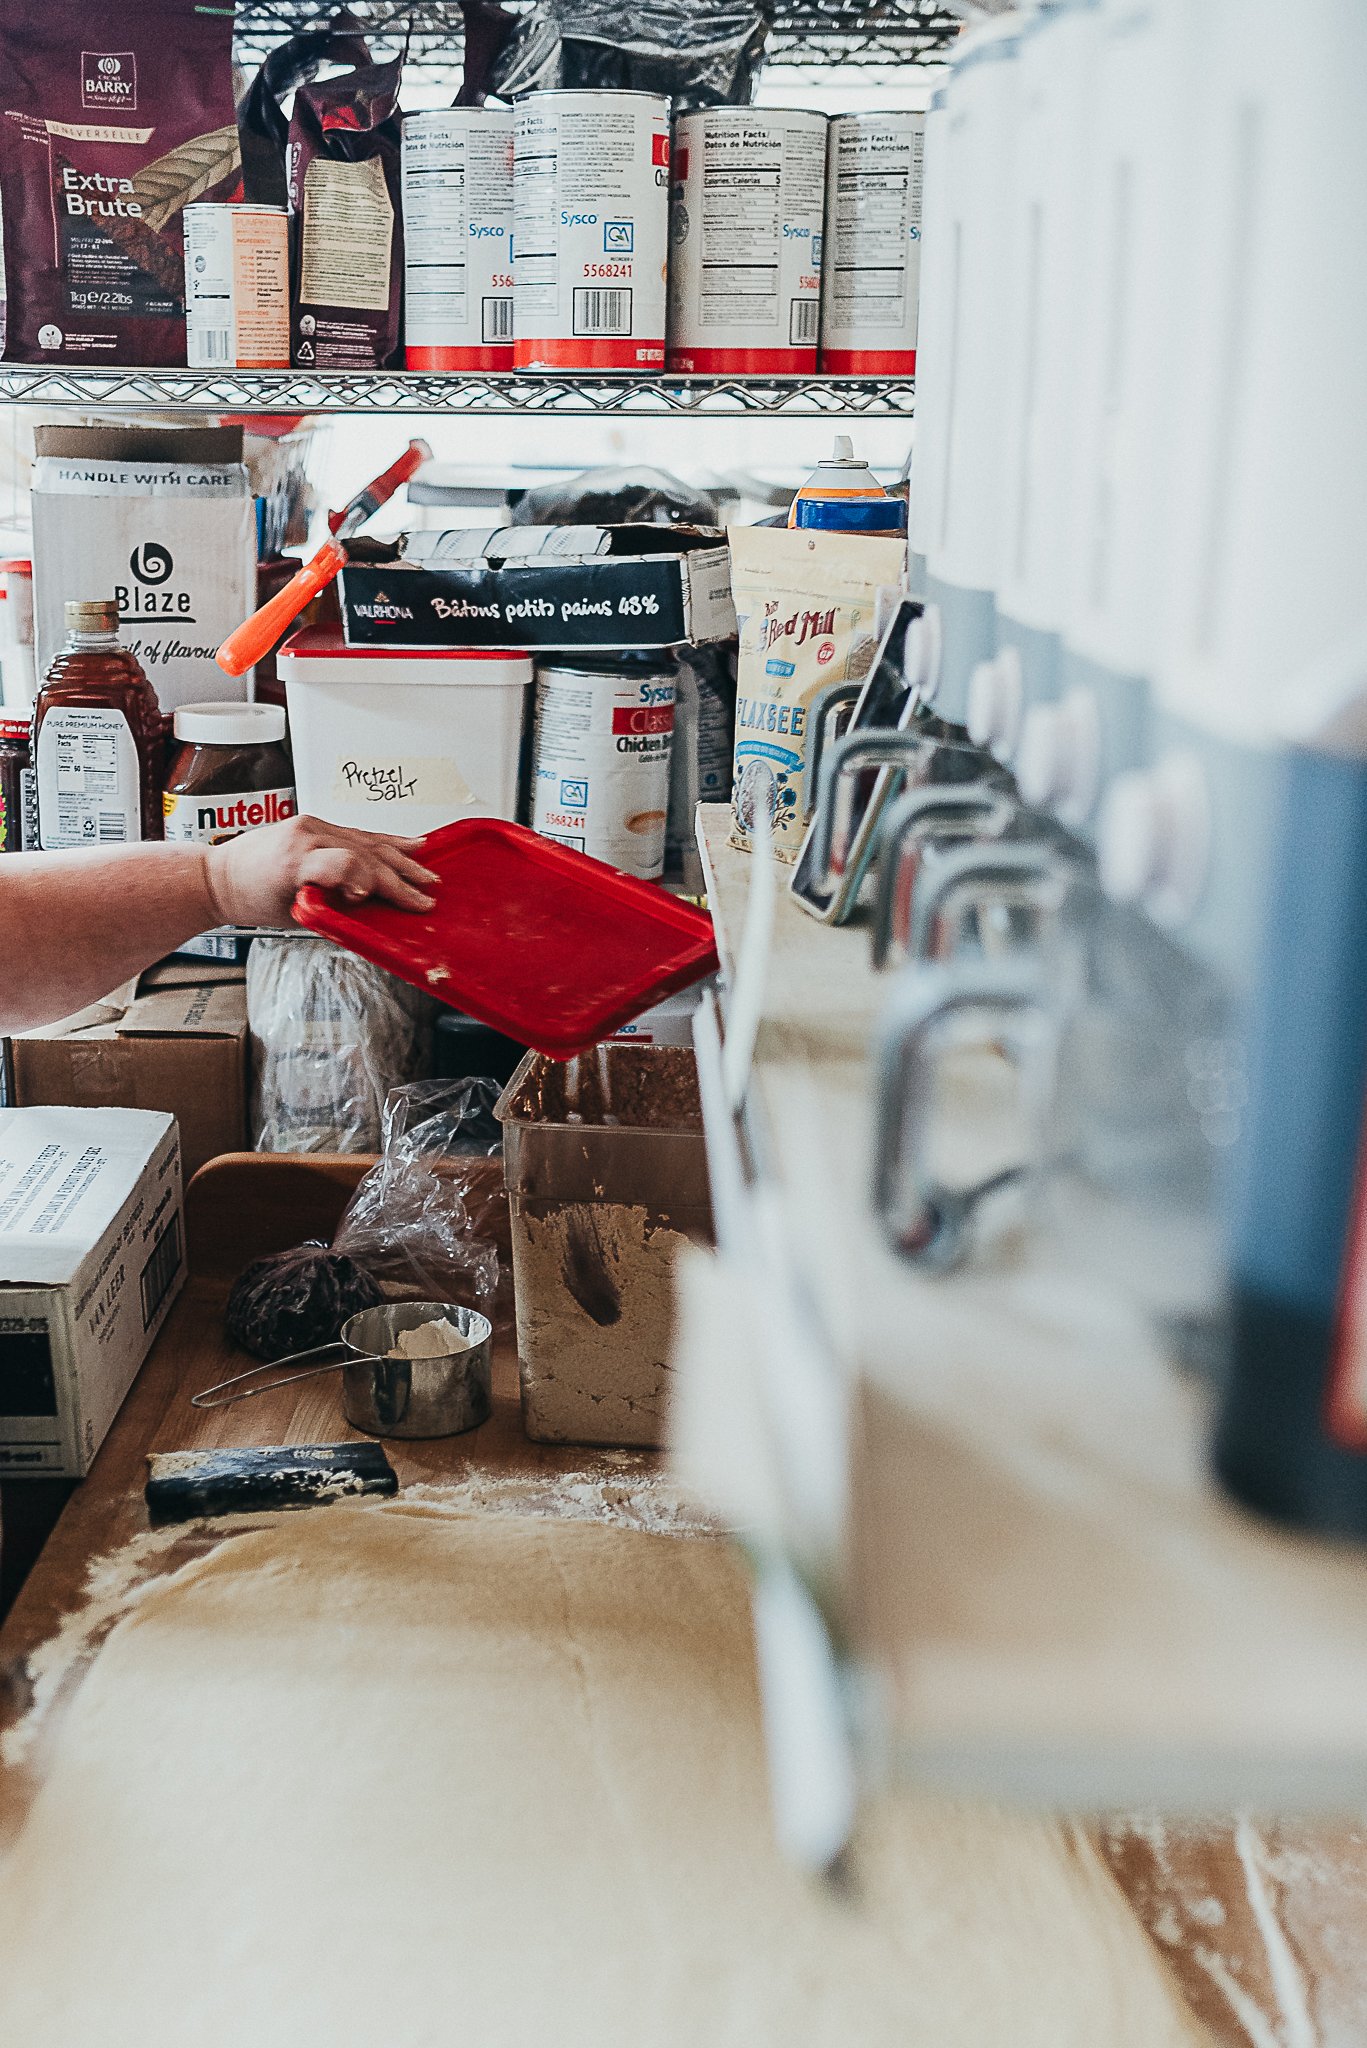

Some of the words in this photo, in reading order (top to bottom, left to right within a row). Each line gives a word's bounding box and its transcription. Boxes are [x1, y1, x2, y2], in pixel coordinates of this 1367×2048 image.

[85, 79, 132, 94] BARRY
[52, 124, 142, 141] UNIVERSELLE
[704, 131, 740, 139] Nutrition
[704, 141, 727, 149] Datos
[729, 140, 740, 148] de
[552, 161, 558, 171] 5
[62, 167, 135, 194] Extra
[459, 174, 465, 184] 5
[775, 174, 781, 185] 5
[902, 178, 908, 188] 5
[66, 193, 143, 218] Brute
[560, 210, 598, 227] Sysco
[469, 223, 505, 239] Sysco
[583, 263, 633, 278] 5568241
[59, 470, 129, 484] HANDLE
[134, 471, 182, 485] WITH
[187, 474, 233, 486] CARE
[114, 586, 191, 613] Blaze
[353, 604, 414, 620] VALRHONA
[430, 597, 501, 619] Bâtons
[505, 598, 555, 624] petits
[561, 597, 613, 622] pains
[618, 594, 660, 616] 48%
[767, 611, 800, 652] Red
[795, 607, 837, 646] Mill
[143, 639, 162, 664] of
[161, 639, 221, 665] flavou
[737, 698, 806, 736] FLAXSEE
[65, 721, 97, 729] PREMIUM
[98, 722, 124, 730] HONEY
[616, 736, 660, 753] Chicken
[342, 761, 403, 788] Pretzel
[197, 792, 295, 830] nutella
